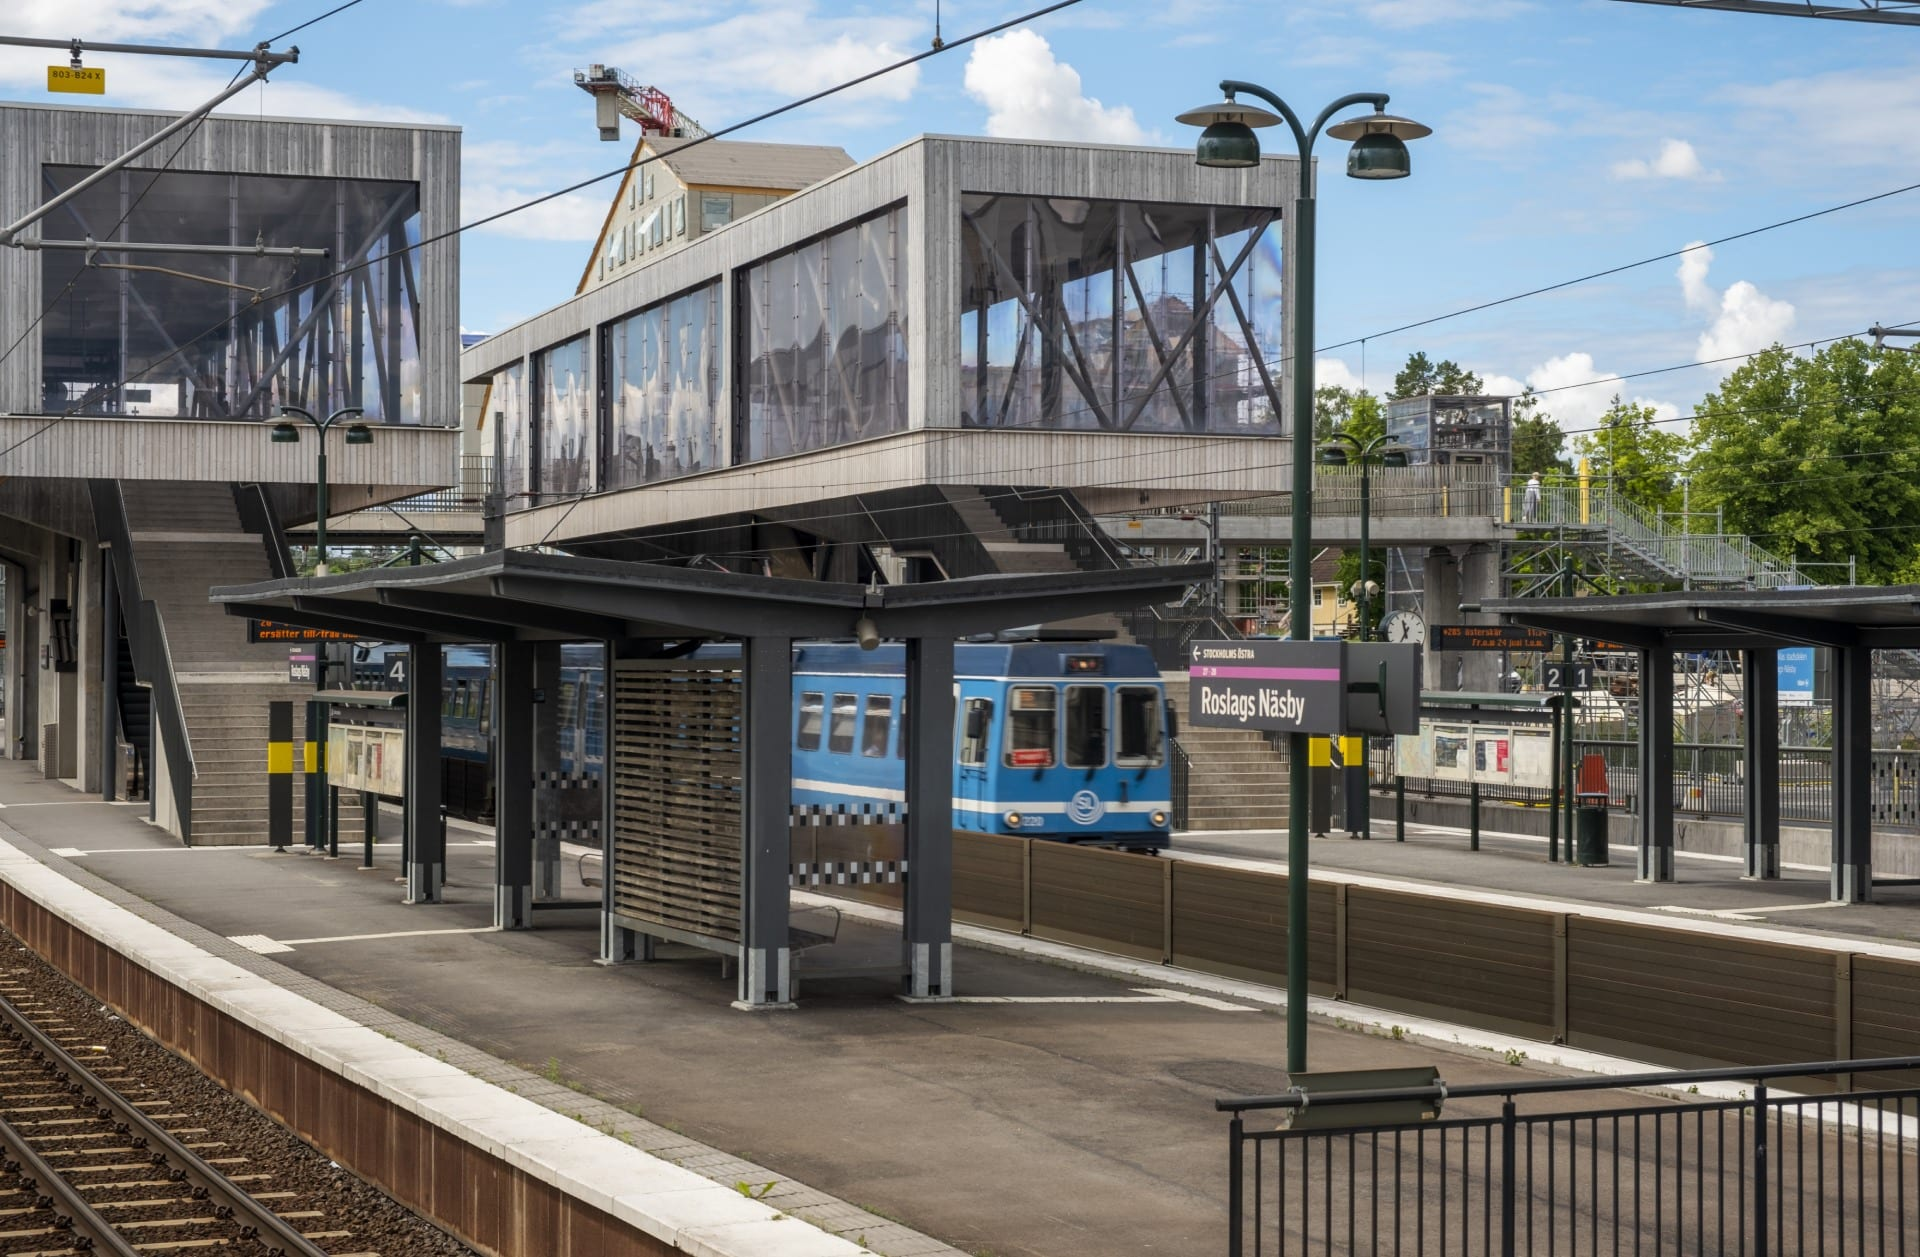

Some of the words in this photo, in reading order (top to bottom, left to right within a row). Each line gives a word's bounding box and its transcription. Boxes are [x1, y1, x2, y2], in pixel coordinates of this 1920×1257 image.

[1203, 648, 1237, 659] STOCKHOLMS
[1238, 647, 1255, 659] ÖSTRA
[389, 660, 406, 683] 4
[1548, 668, 1560, 688] 2
[1577, 668, 1588, 688] 1
[1201, 686, 1256, 722] Roslags
[1259, 688, 1305, 725] Näsby
